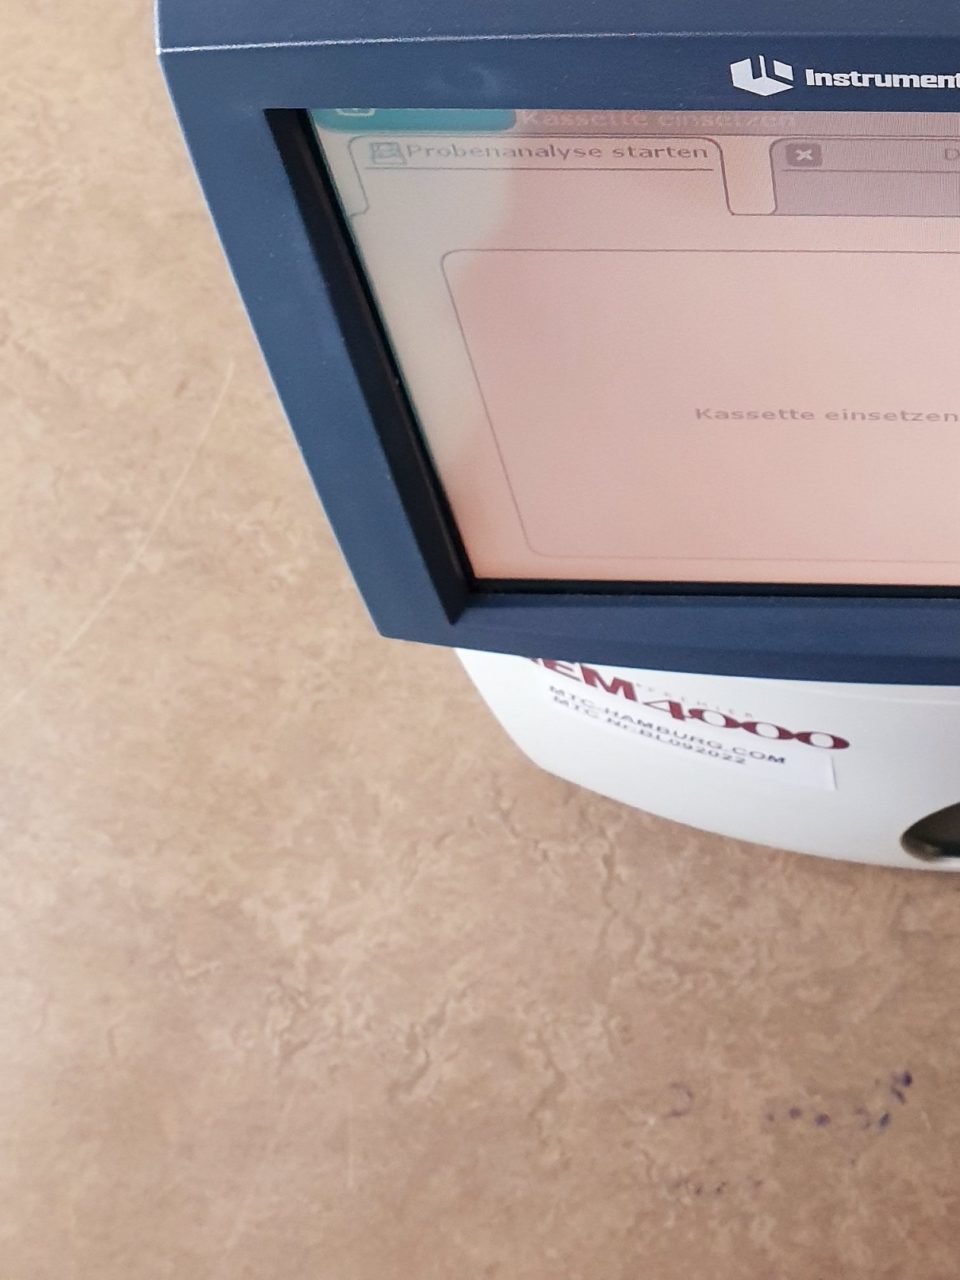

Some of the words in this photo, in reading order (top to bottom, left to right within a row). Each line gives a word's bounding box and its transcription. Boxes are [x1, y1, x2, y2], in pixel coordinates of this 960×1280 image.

[406, 144, 602, 161] Probenanalyse
[612, 145, 708, 160] starten
[694, 407, 816, 421] Kassette
[824, 408, 959, 422] einsetzen
